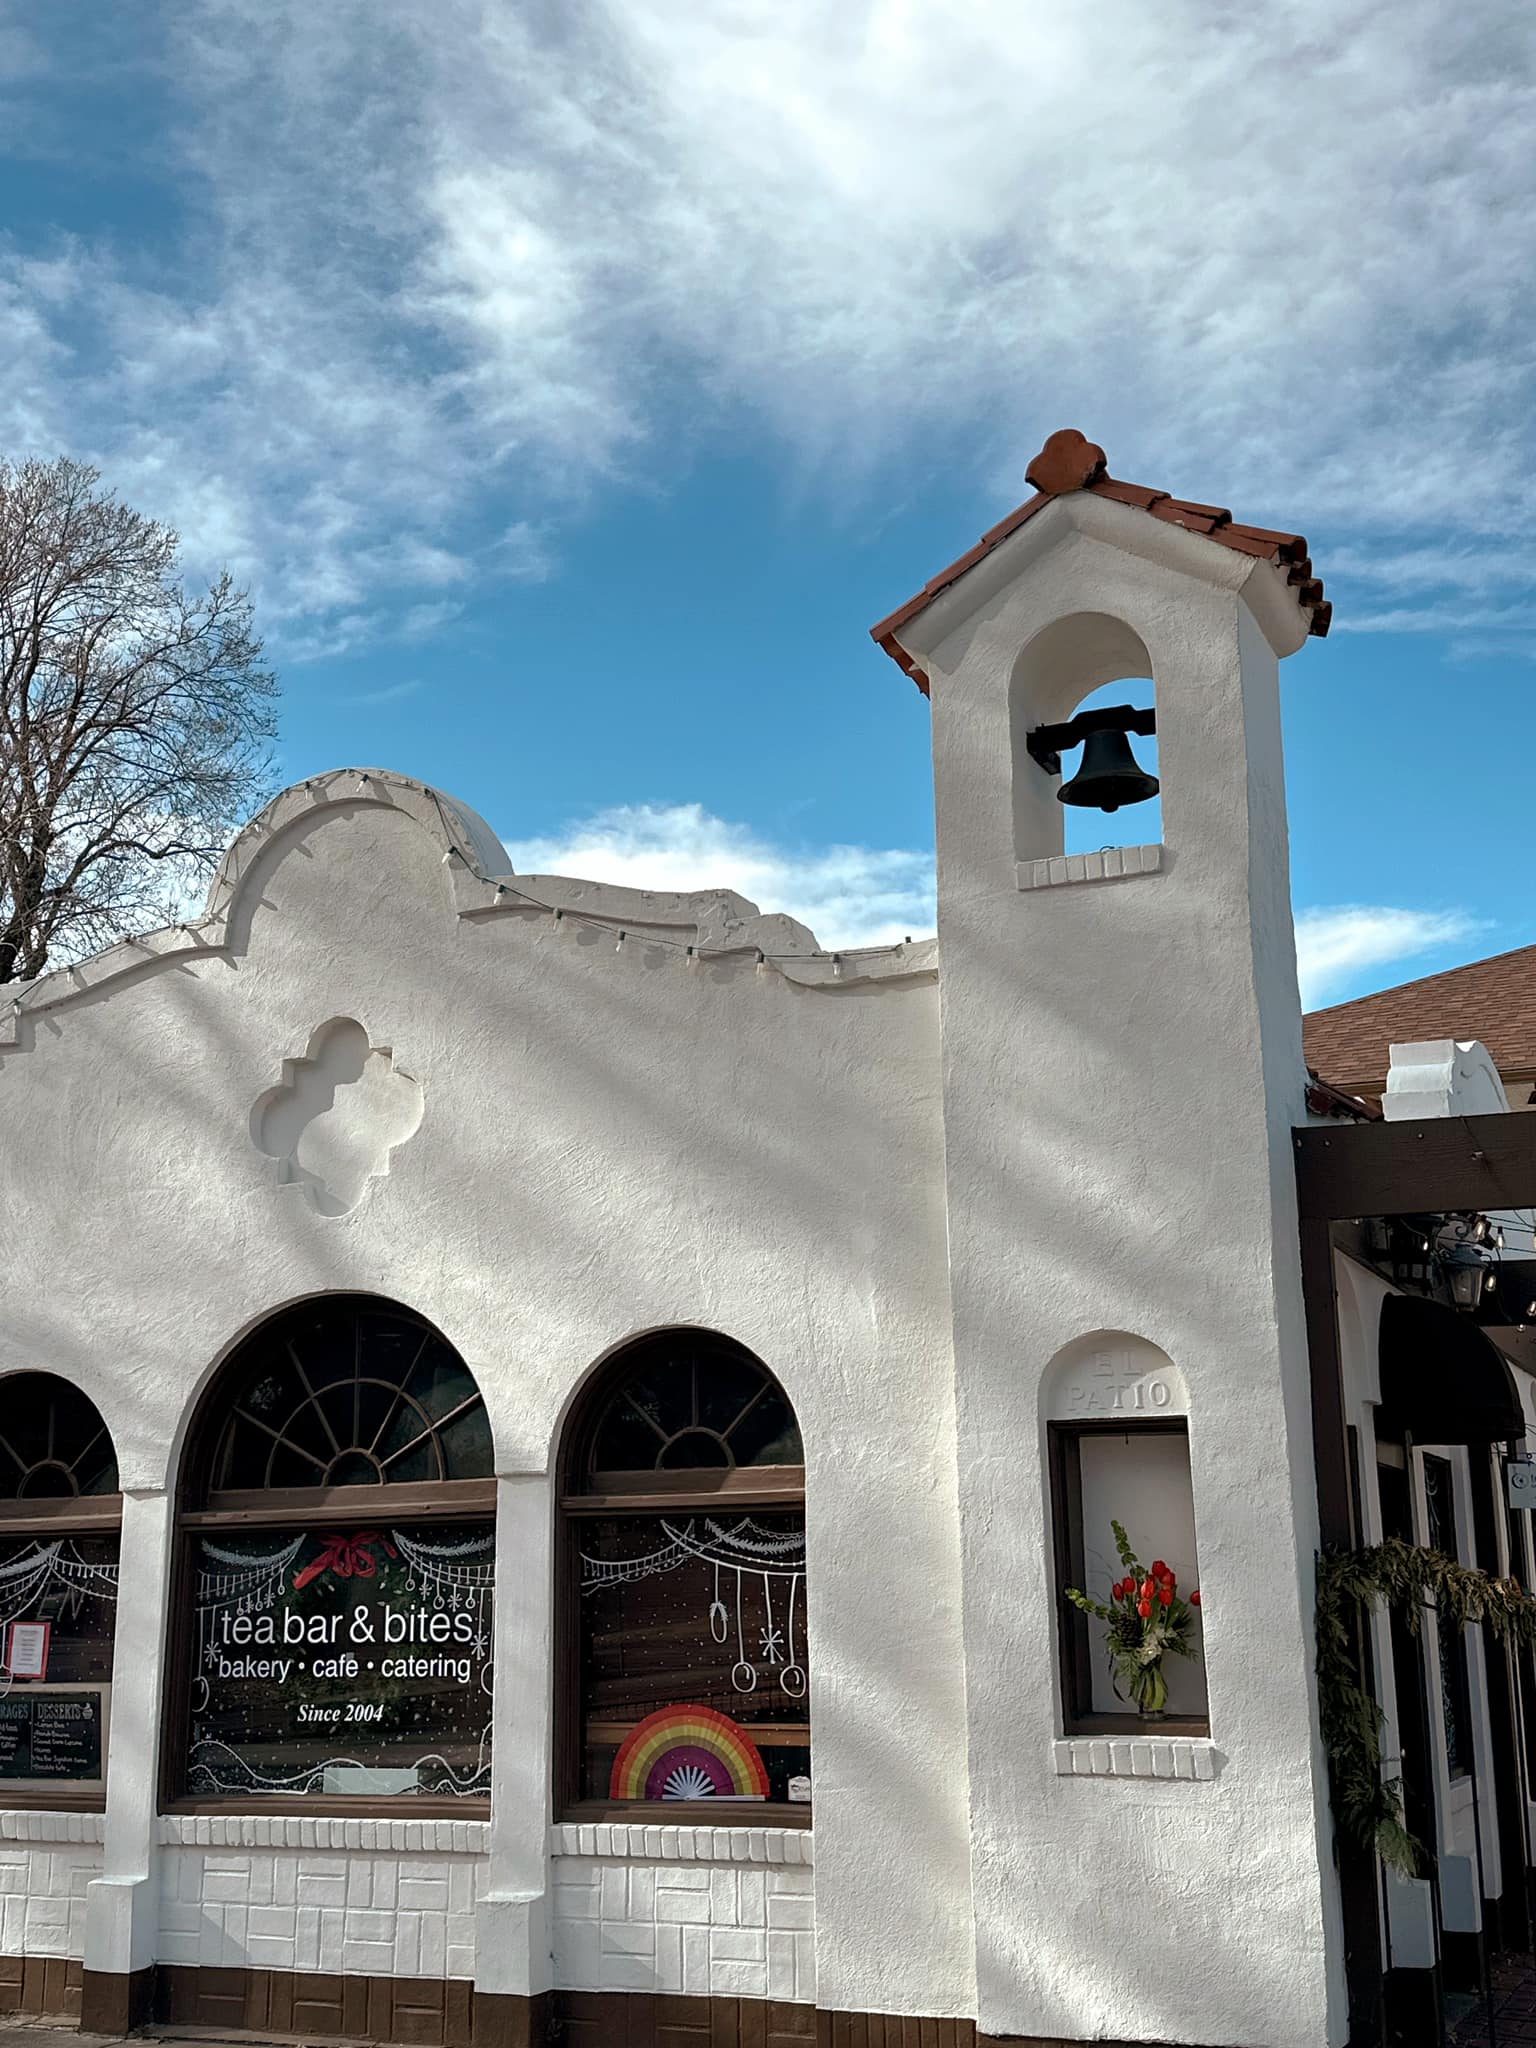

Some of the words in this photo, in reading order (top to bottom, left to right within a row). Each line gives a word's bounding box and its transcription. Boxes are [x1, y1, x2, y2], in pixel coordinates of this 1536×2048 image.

[1089, 1351, 1143, 1377] EL
[1065, 1380, 1172, 1411] PATIO
[221, 1610, 276, 1644] tea
[283, 1606, 344, 1644] bar
[349, 1605, 376, 1643] &
[384, 1603, 473, 1642] bites
[219, 1654, 292, 1684] bakery
[312, 1653, 359, 1678] cafe
[381, 1652, 471, 1684] catering
[37, 1703, 82, 1720] DESSERTS
[297, 1704, 341, 1722] Since
[343, 1704, 384, 1722] 2004
